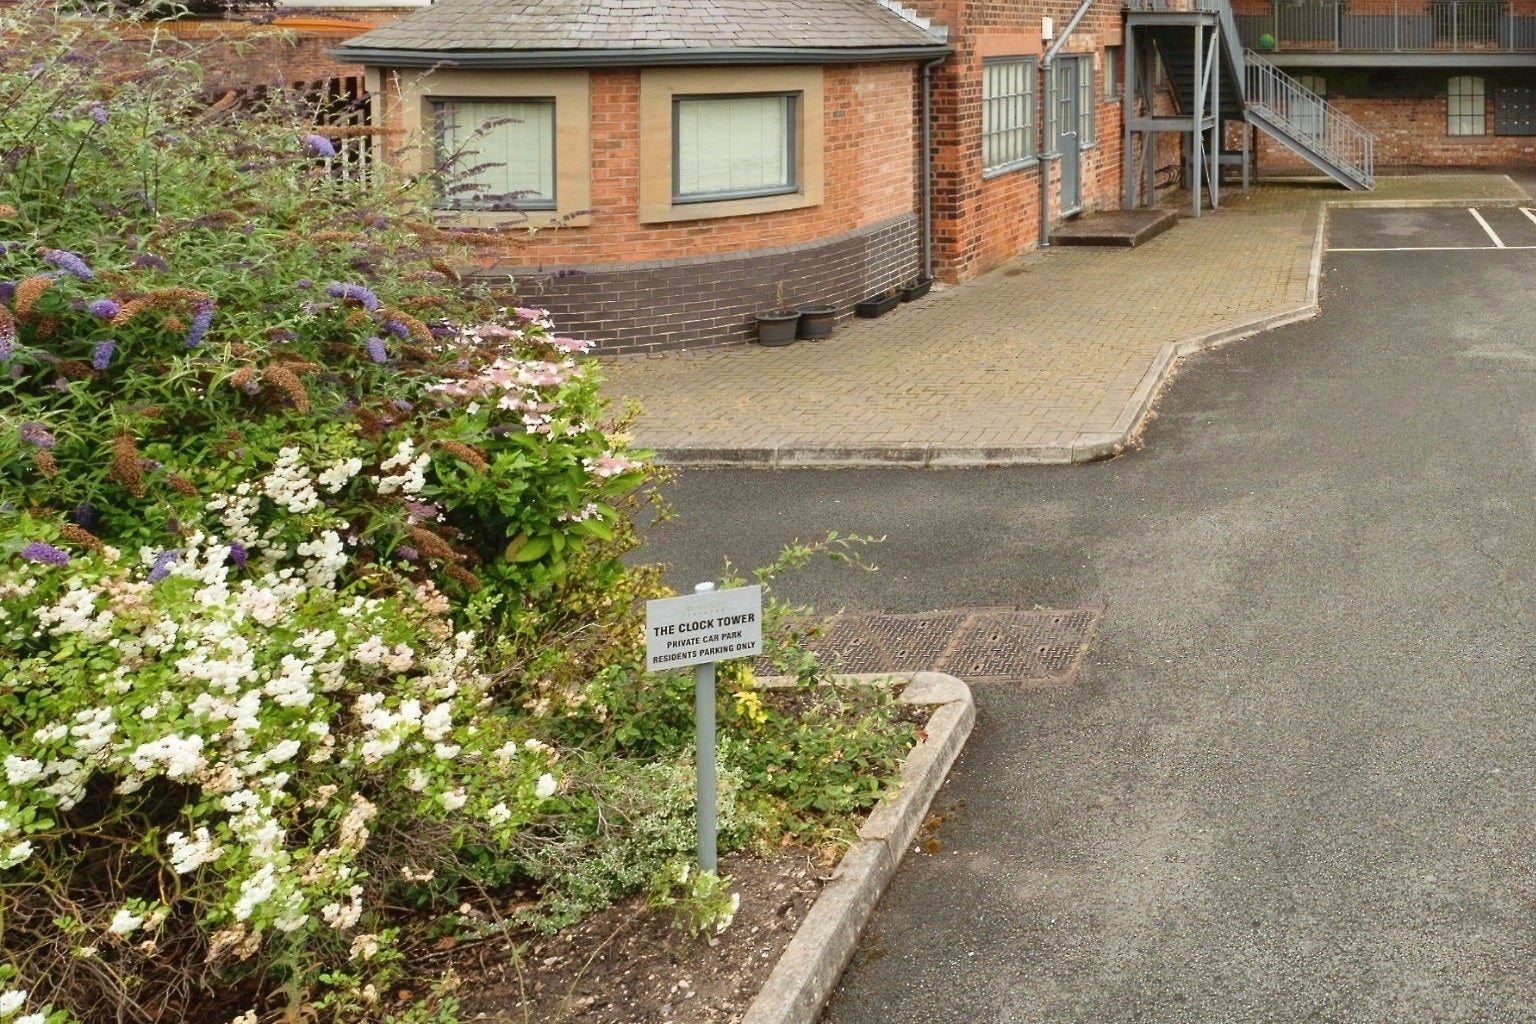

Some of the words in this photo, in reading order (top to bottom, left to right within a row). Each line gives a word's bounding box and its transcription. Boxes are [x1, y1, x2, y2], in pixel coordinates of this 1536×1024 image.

[654, 625, 675, 636] THE
[678, 619, 714, 633] CLOCK
[717, 613, 755, 627] TOWER
[667, 637, 700, 649] PRIVATE
[702, 633, 719, 643] CAR
[721, 630, 742, 640] PARK
[652, 650, 697, 664] RESIDENTS
[700, 644, 734, 657] PARKING
[736, 641, 756, 651] ONLY
